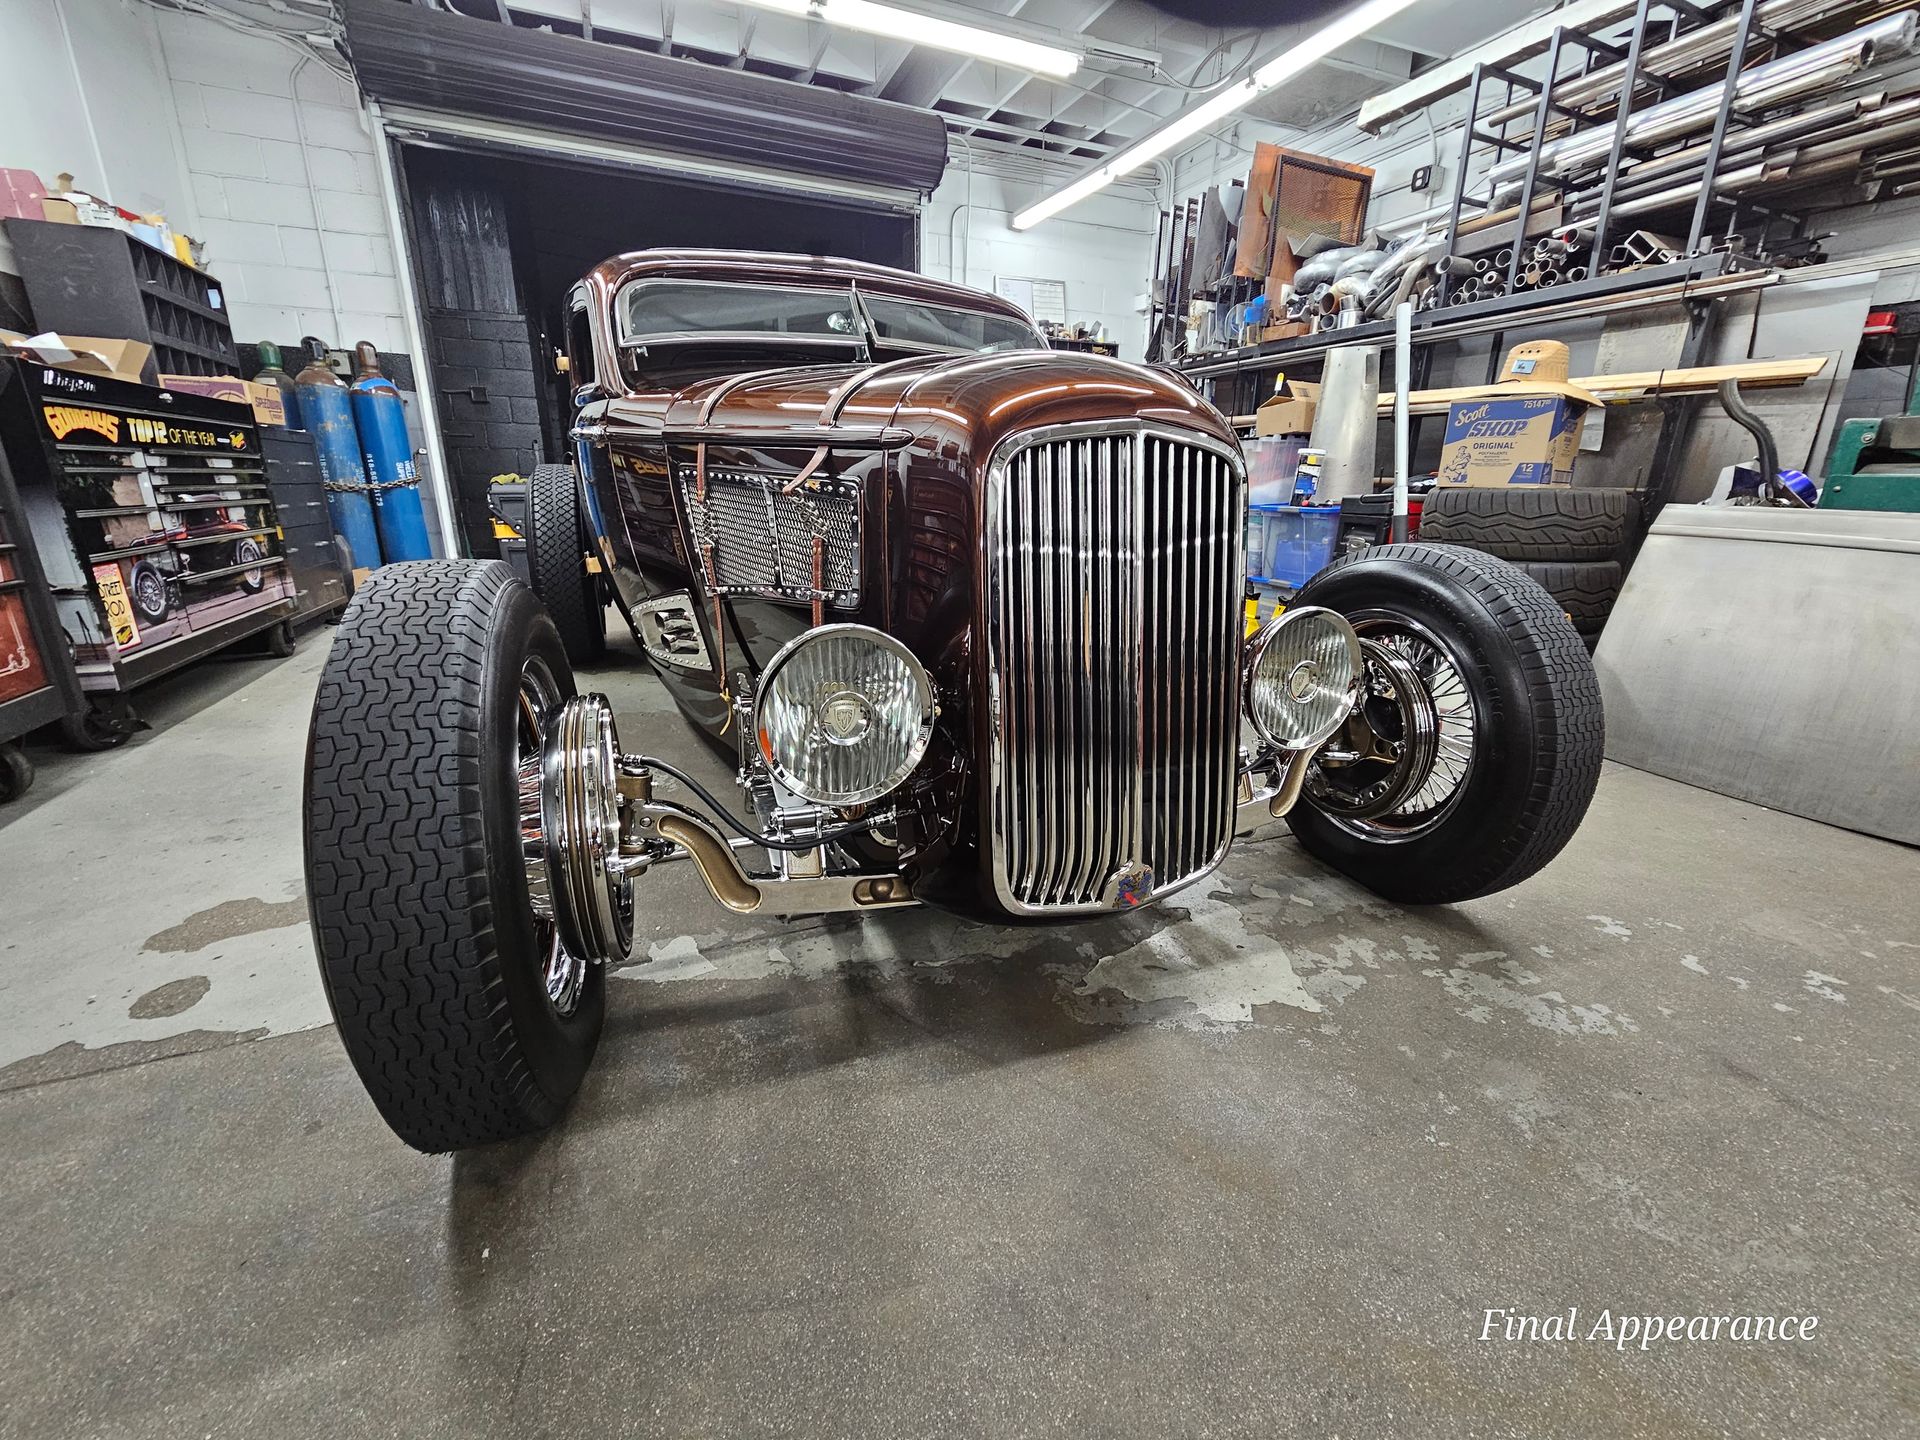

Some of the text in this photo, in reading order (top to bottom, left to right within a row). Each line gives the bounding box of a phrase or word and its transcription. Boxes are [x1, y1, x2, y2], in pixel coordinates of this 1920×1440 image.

[1455, 403, 1490, 427] Scott
[126, 417, 154, 442] TOP
[152, 421, 168, 444] 12
[169, 428, 181, 443] OF
[181, 429, 198, 445] THE
[197, 431, 217, 446] YEAR
[1467, 419, 1530, 438] SHOP
[1473, 442, 1515, 450] ORIGINAL
[1521, 463, 1535, 473] 12
